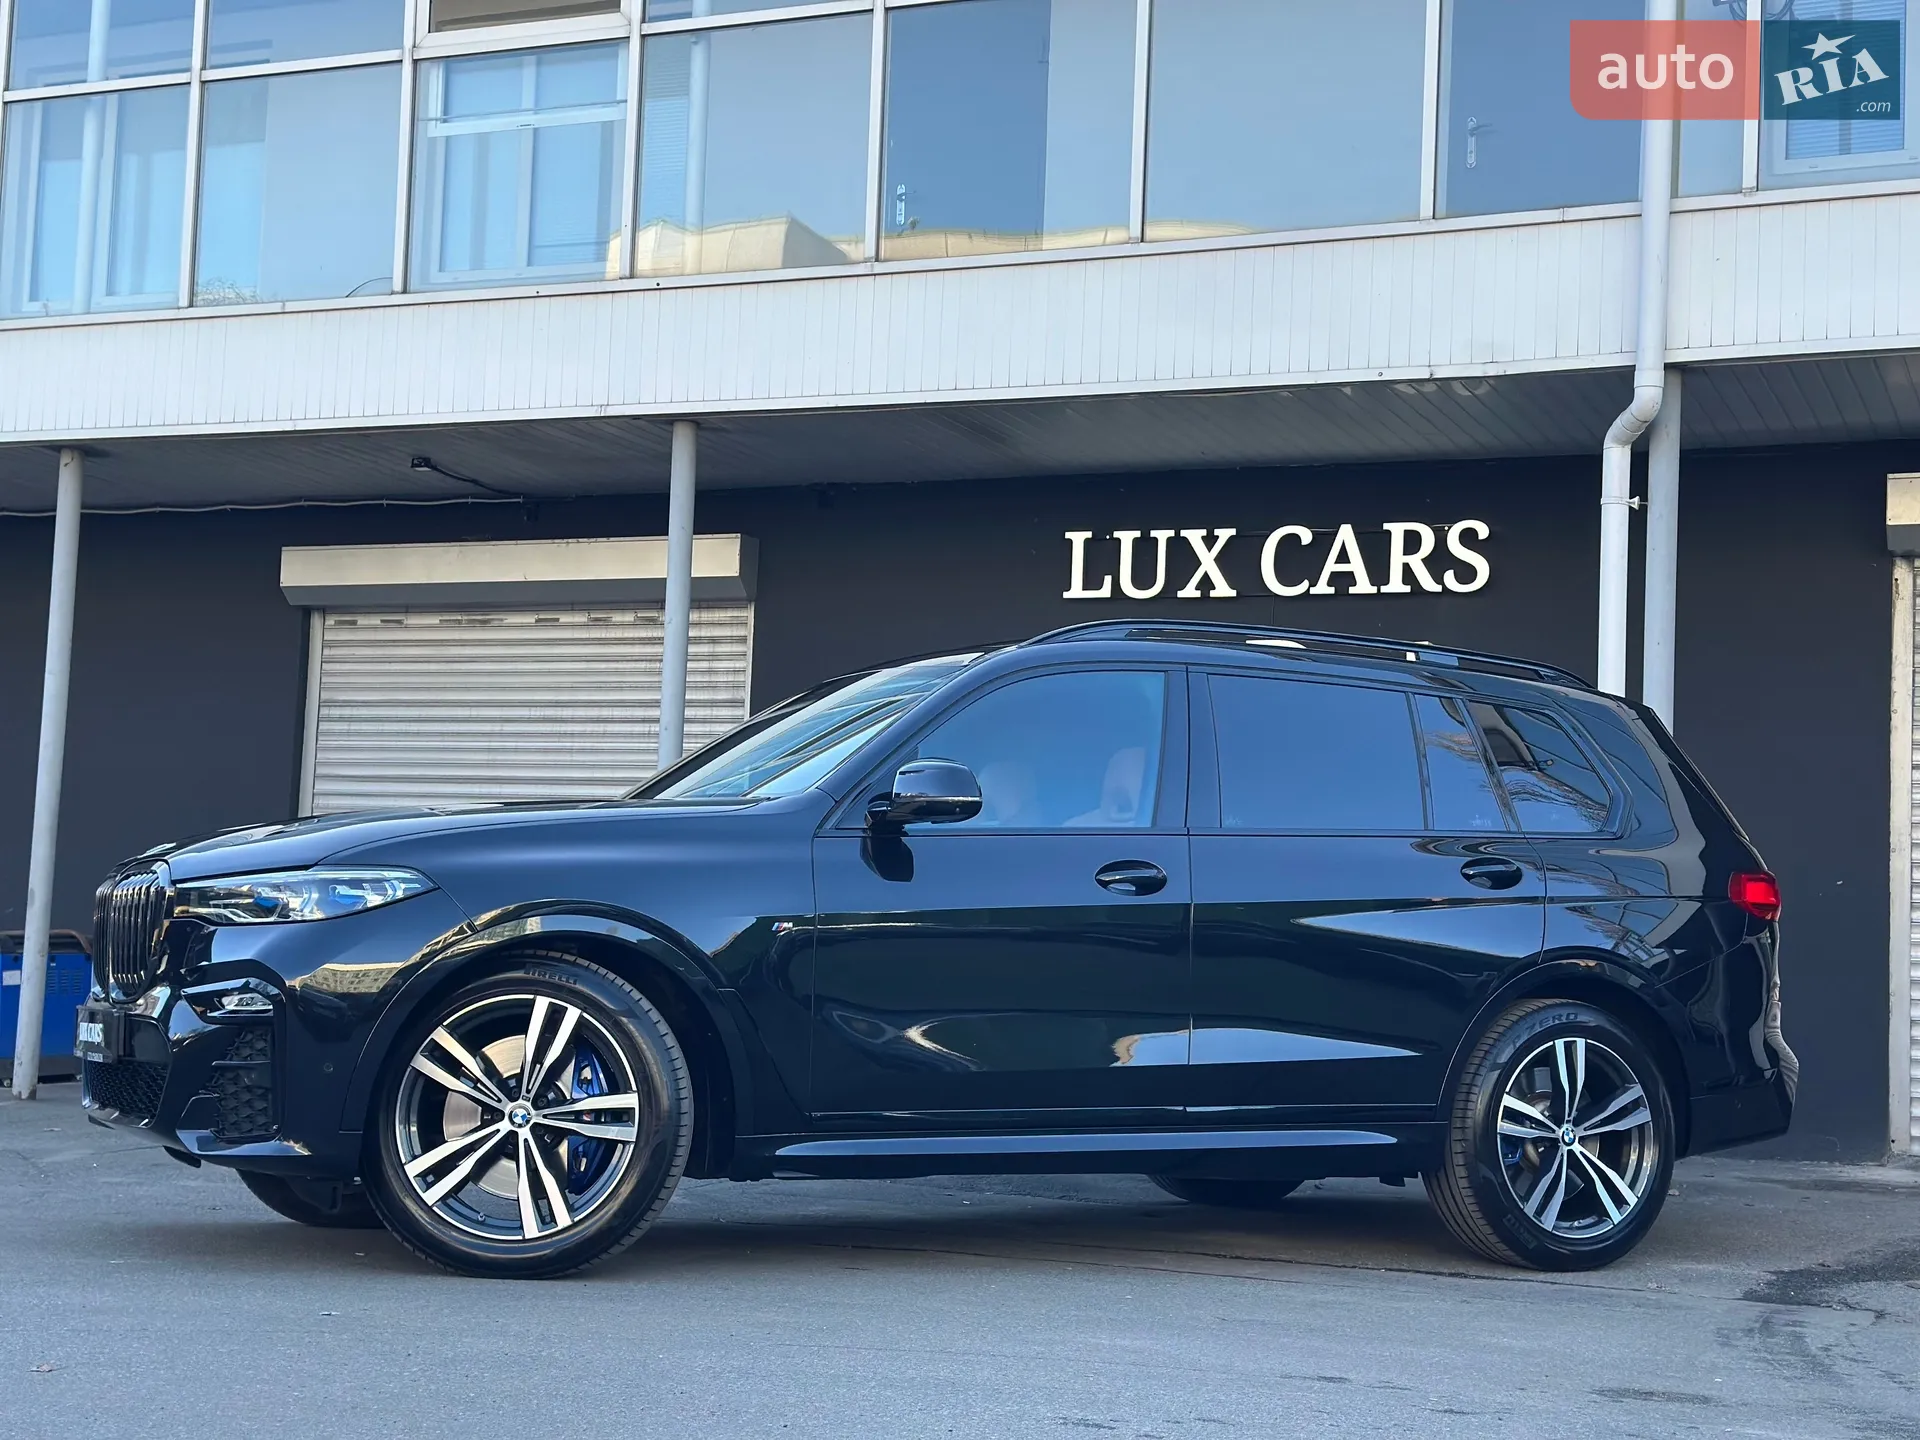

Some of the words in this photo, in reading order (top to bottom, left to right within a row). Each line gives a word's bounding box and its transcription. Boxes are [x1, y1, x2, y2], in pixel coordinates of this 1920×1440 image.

[1062, 528, 1237, 599] LUX
[1260, 519, 1490, 597] CARS
[524, 963, 579, 986] PIRELLI
[1525, 1012, 1578, 1033] ZERO
